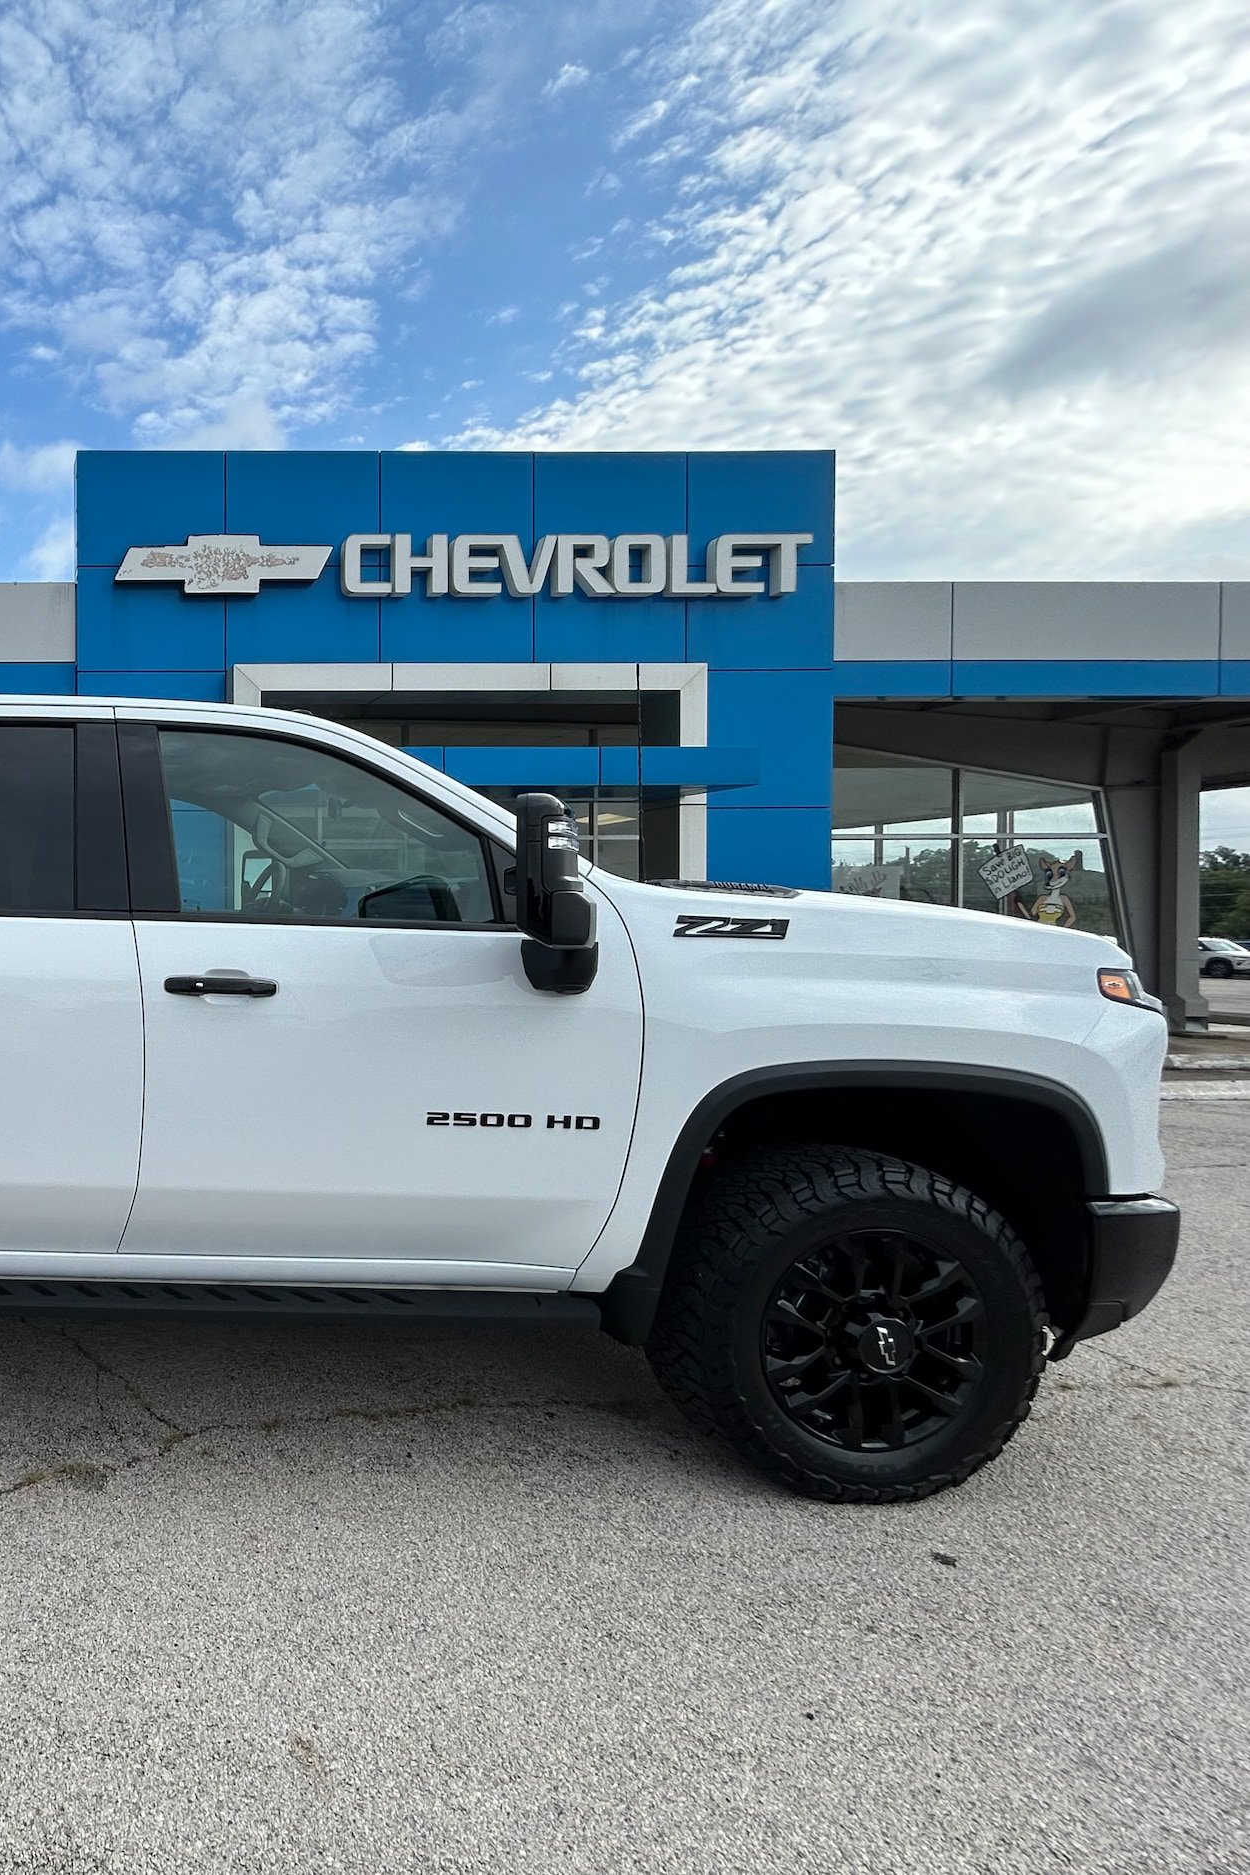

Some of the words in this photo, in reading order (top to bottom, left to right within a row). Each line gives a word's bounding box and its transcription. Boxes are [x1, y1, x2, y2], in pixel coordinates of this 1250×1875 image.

[341, 533, 814, 598] CHEVROLET
[982, 857, 1005, 876] Save
[673, 914, 790, 940] Z71
[426, 1111, 532, 1128] 2500
[546, 1114, 601, 1130] HD
